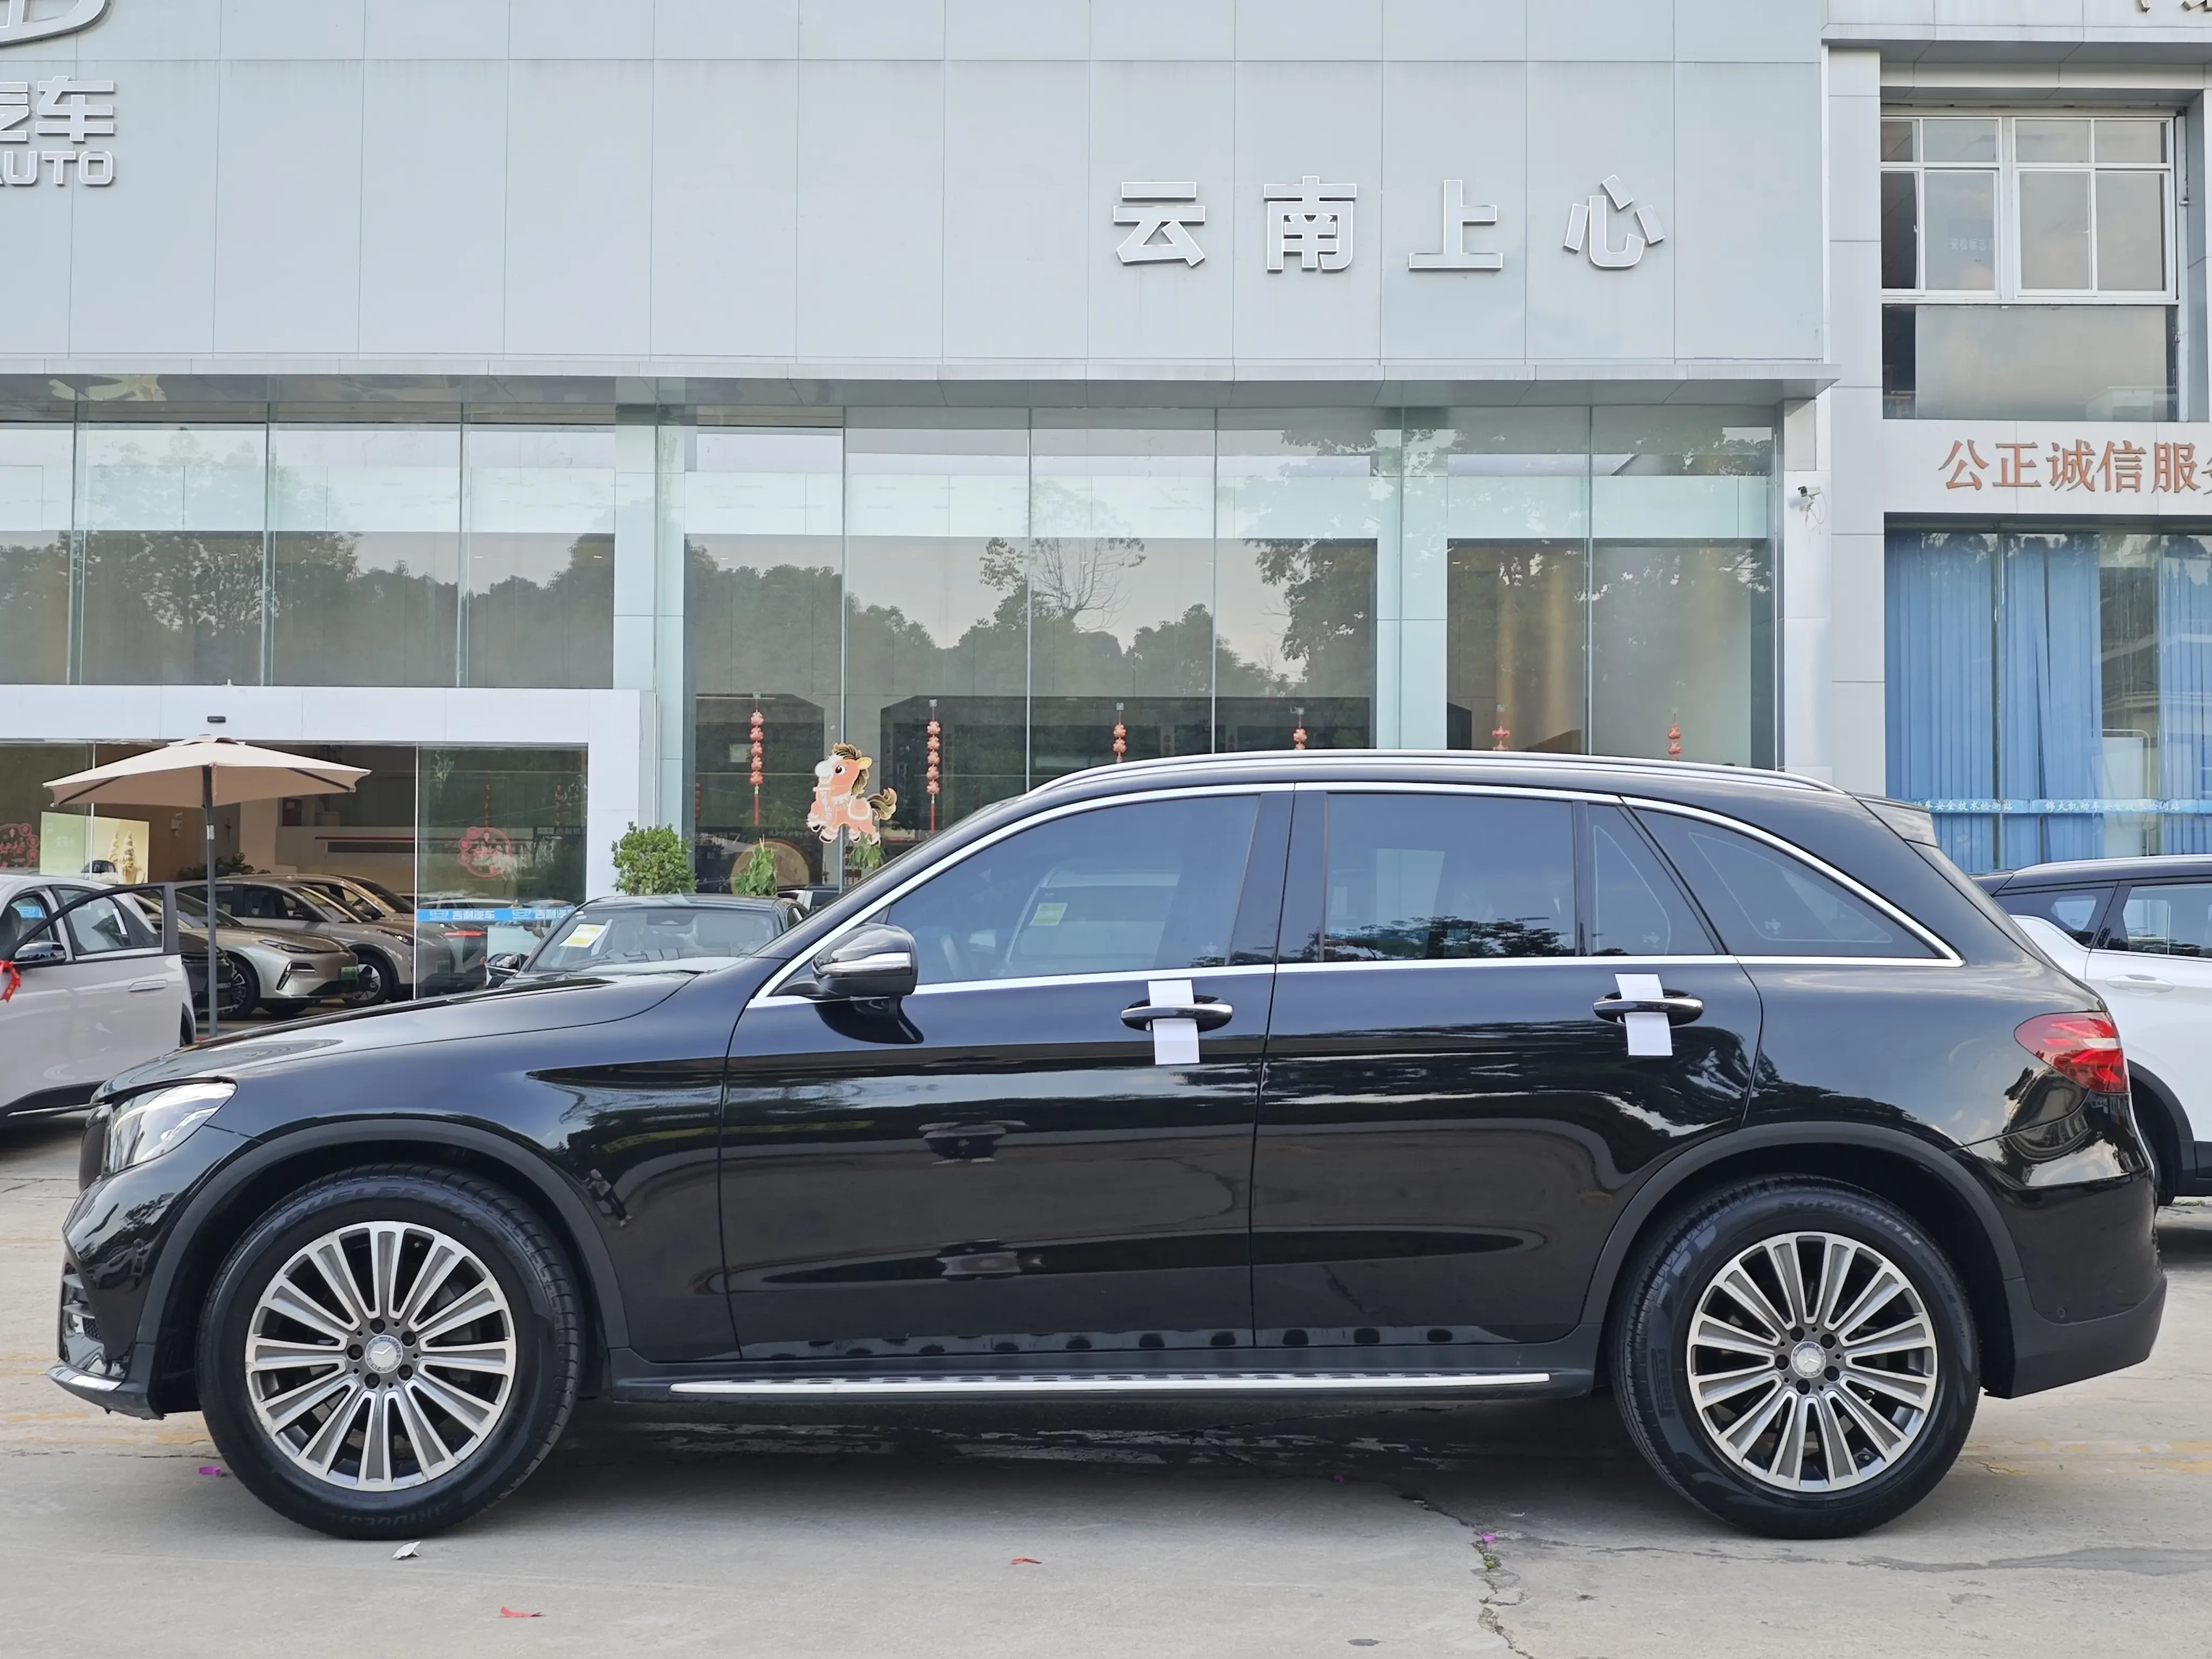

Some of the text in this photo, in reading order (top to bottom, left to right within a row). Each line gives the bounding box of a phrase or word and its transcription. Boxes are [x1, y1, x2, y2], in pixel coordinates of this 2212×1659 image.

[0, 151, 114, 186] UTO
[1114, 174, 1665, 271] 云南上心
[1938, 439, 2212, 495] 公正诚信服
[452, 909, 495, 920] 吉利汽车
[1778, 1197, 1920, 1245] SCORPION
